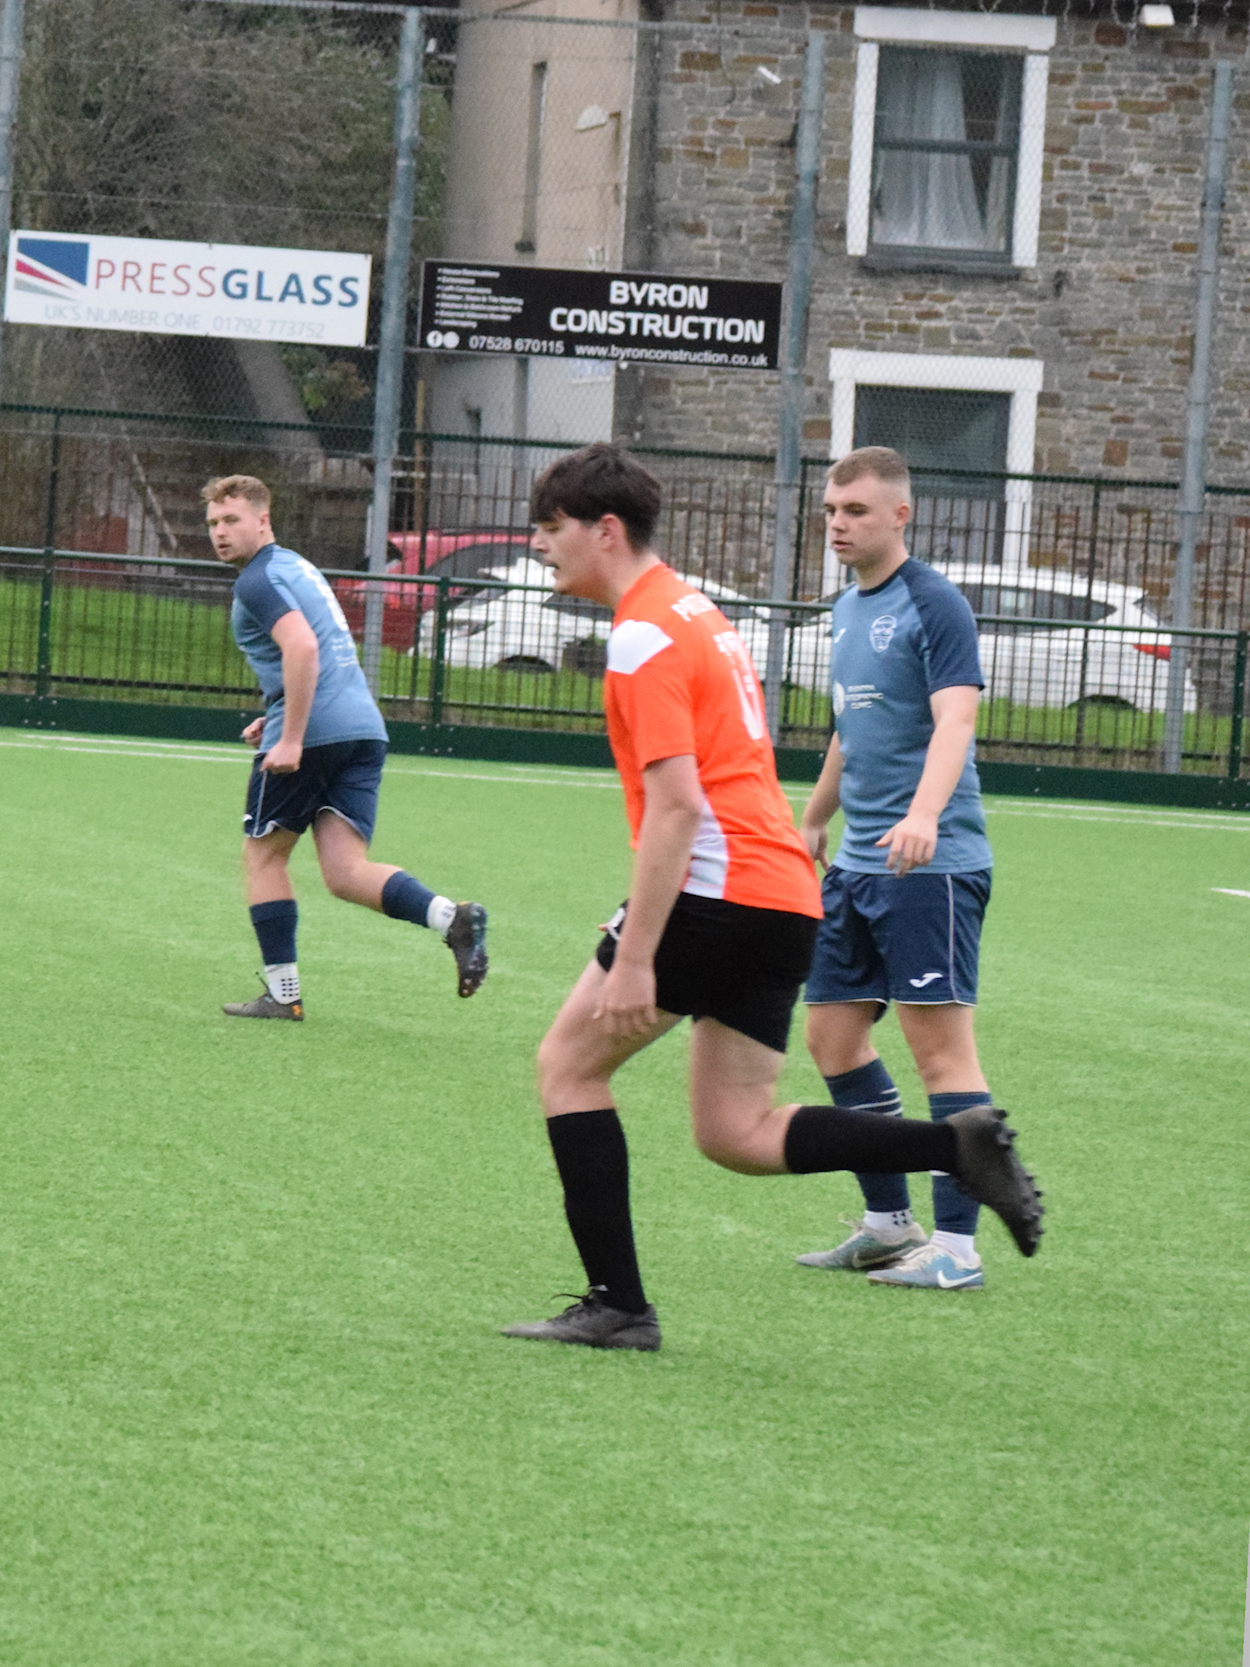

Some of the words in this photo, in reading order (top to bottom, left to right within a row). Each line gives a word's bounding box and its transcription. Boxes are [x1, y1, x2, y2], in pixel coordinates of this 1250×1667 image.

[609, 279, 709, 311] BYRON
[85, 305, 159, 327] NUMBER
[163, 311, 201, 330] ONE
[212, 314, 262, 335] 01792
[549, 307, 766, 344] CONSTRUCTION
[468, 335, 512, 351] 07528
[514, 338, 565, 355] 670115
[574, 343, 769, 368] www.byronconstruction.co.uk
